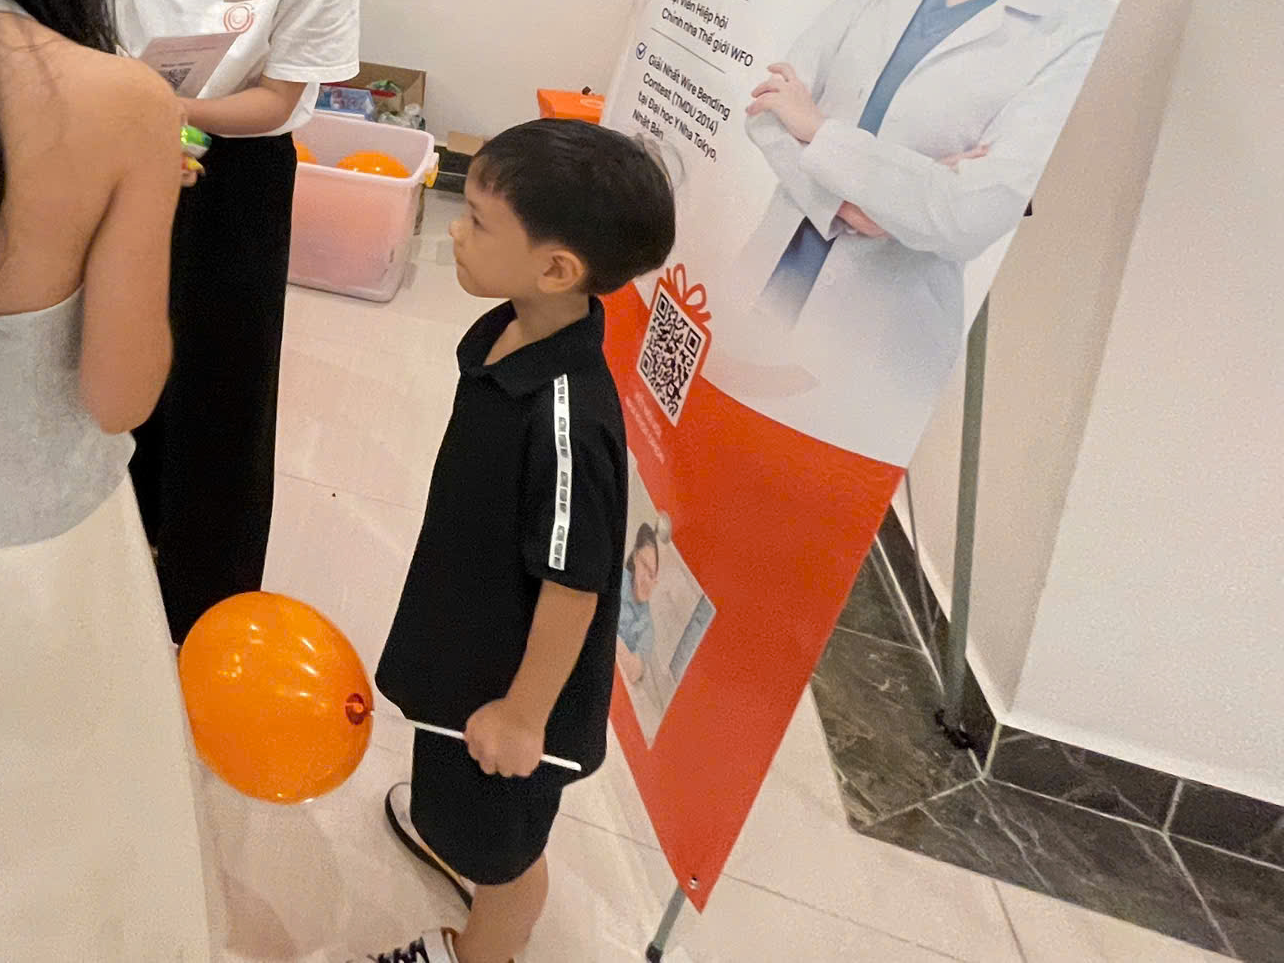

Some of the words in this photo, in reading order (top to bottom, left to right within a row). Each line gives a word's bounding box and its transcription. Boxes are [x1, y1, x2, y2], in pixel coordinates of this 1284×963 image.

[683, 21, 698, 37] nha
[698, 27, 715, 46] Thế
[730, 45, 754, 67] WFO
[643, 72, 672, 100] Contest
[671, 91, 697, 117] (TMDU
[695, 110, 719, 136] 2014)
[680, 74, 697, 95] Wire
[696, 86, 731, 121] Bending
[678, 121, 693, 141] Nha
[693, 132, 717, 162] Tokyo,
